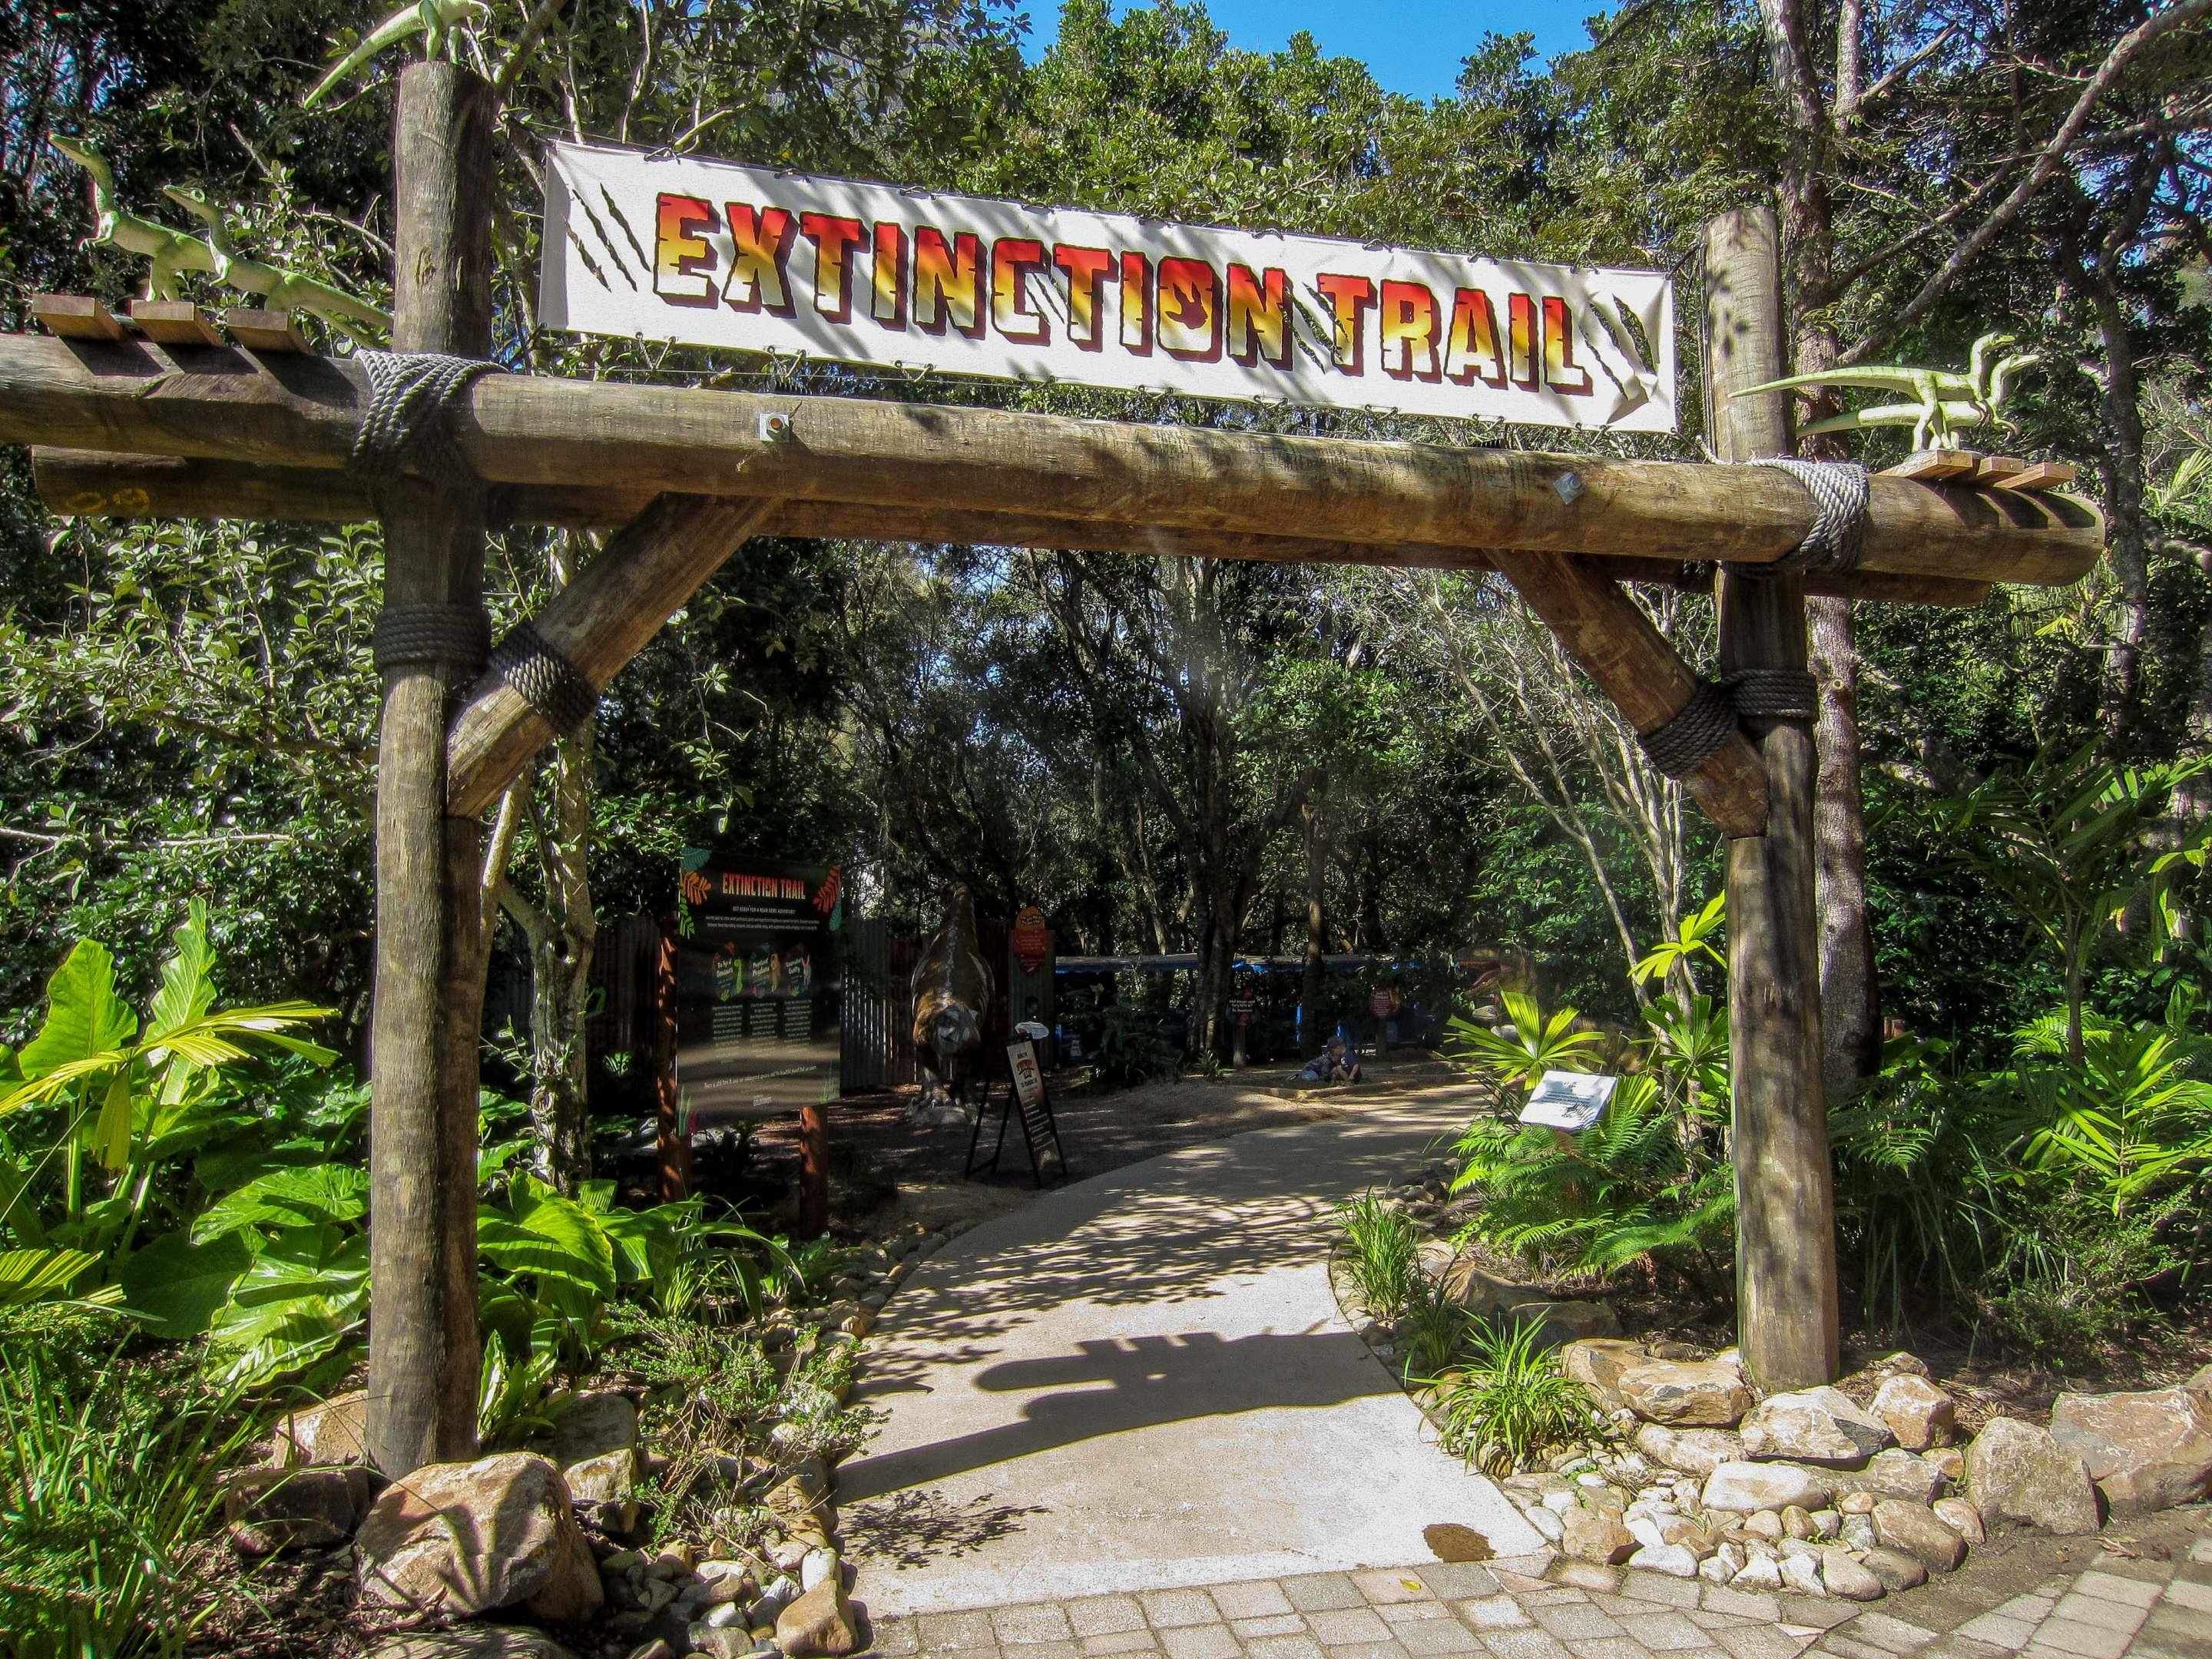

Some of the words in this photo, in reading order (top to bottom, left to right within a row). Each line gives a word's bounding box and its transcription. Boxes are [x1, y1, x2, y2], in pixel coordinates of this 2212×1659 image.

[654, 192, 1294, 372] EXTINCTION
[1317, 272, 1594, 397] TRAIL
[723, 873, 778, 898] EXTINCTION
[780, 877, 806, 899] TRAIL
